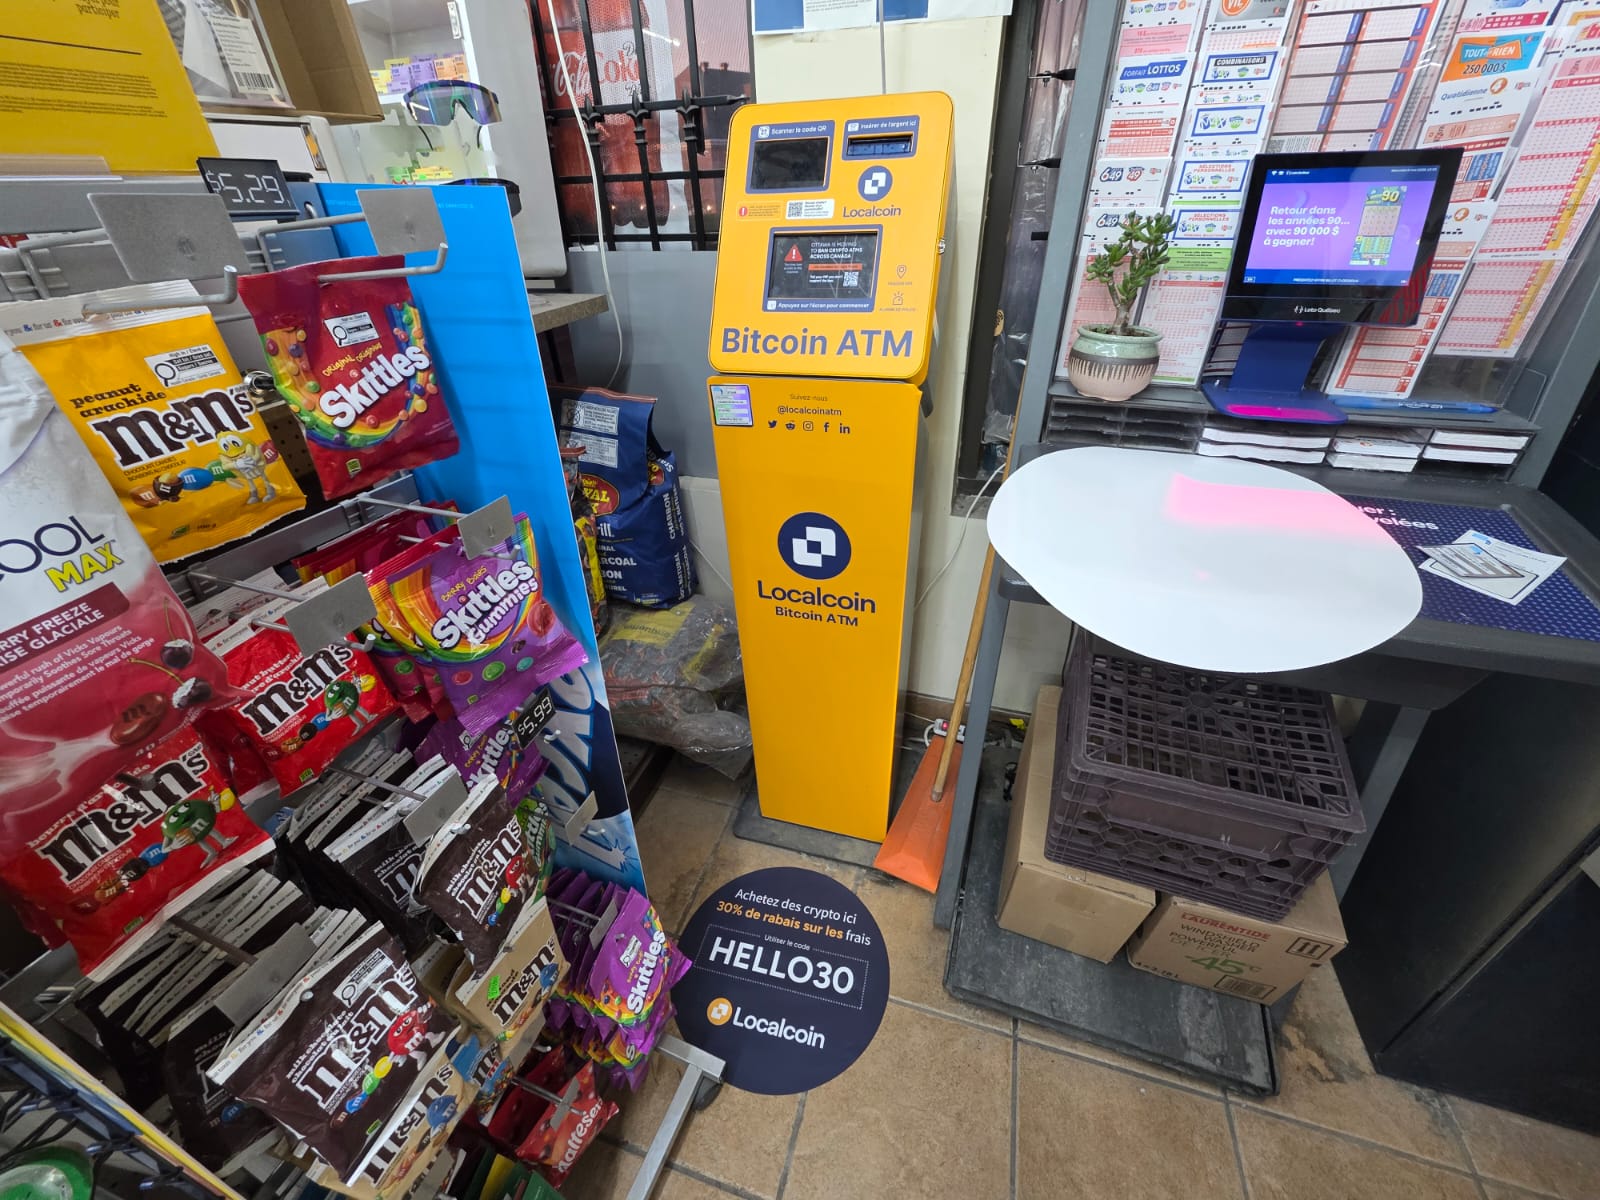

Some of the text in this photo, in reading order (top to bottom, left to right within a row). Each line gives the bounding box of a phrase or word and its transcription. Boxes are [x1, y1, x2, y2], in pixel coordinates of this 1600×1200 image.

[1464, 47, 1516, 58] TOUT RIEN
[1147, 64, 1181, 74] LOTTOS
[1463, 64, 1480, 74] 250
[1441, 88, 1488, 100] Quotidienne
[205, 170, 285, 204] $5.29
[843, 206, 901, 219] Localcoin
[1270, 206, 1337, 215] Retour dans
[1285, 216, 1326, 225] années
[1263, 236, 1315, 247] à gagner!
[1266, 226, 1340, 236] avec 90 000 $
[722, 328, 913, 357] Bitcoin ATM
[71, 383, 142, 408] peanut
[319, 346, 430, 428] Skittles
[80, 390, 167, 418] arachide
[777, 405, 842, 416] @localcoinatm
[663, 493, 676, 540] CHARBON
[44, 541, 124, 592] MAX
[432, 561, 535, 649] Skittles
[467, 577, 538, 645] Gummies
[757, 580, 877, 613] Localcoin
[0, 603, 92, 651] RRY FREEZE
[775, 606, 859, 627] Bitcoin ATM
[0, 610, 104, 667] ISE GLACIALE
[31, 661, 52, 674] rush
[53, 653, 64, 664] of
[63, 643, 88, 657] Vicks
[87, 626, 122, 644] Vapours
[43, 657, 82, 677] Soothes
[81, 646, 101, 659] Sore
[100, 629, 132, 647] Throats
[22, 637, 155, 711] temporairement le mal de gorge
[32, 636, 142, 698] puissante de vapeurs Vicks
[260, 654, 291, 677] butter
[518, 696, 552, 736] $5.99
[446, 872, 462, 893] milk
[735, 888, 857, 924] Achetez des crypto ici
[716, 901, 871, 946] 30% de rabais sur les frais
[1181, 912, 1272, 940] LAURENTIDE
[764, 934, 810, 951] Utiliser le code
[1169, 931, 1237, 954] POWERFUL
[627, 930, 666, 1014] Skittles
[708, 936, 854, 994] HELLO30
[732, 1006, 826, 1049] Localcoin
[286, 1054, 307, 1080] milk
[291, 1040, 329, 1084] chocolat
